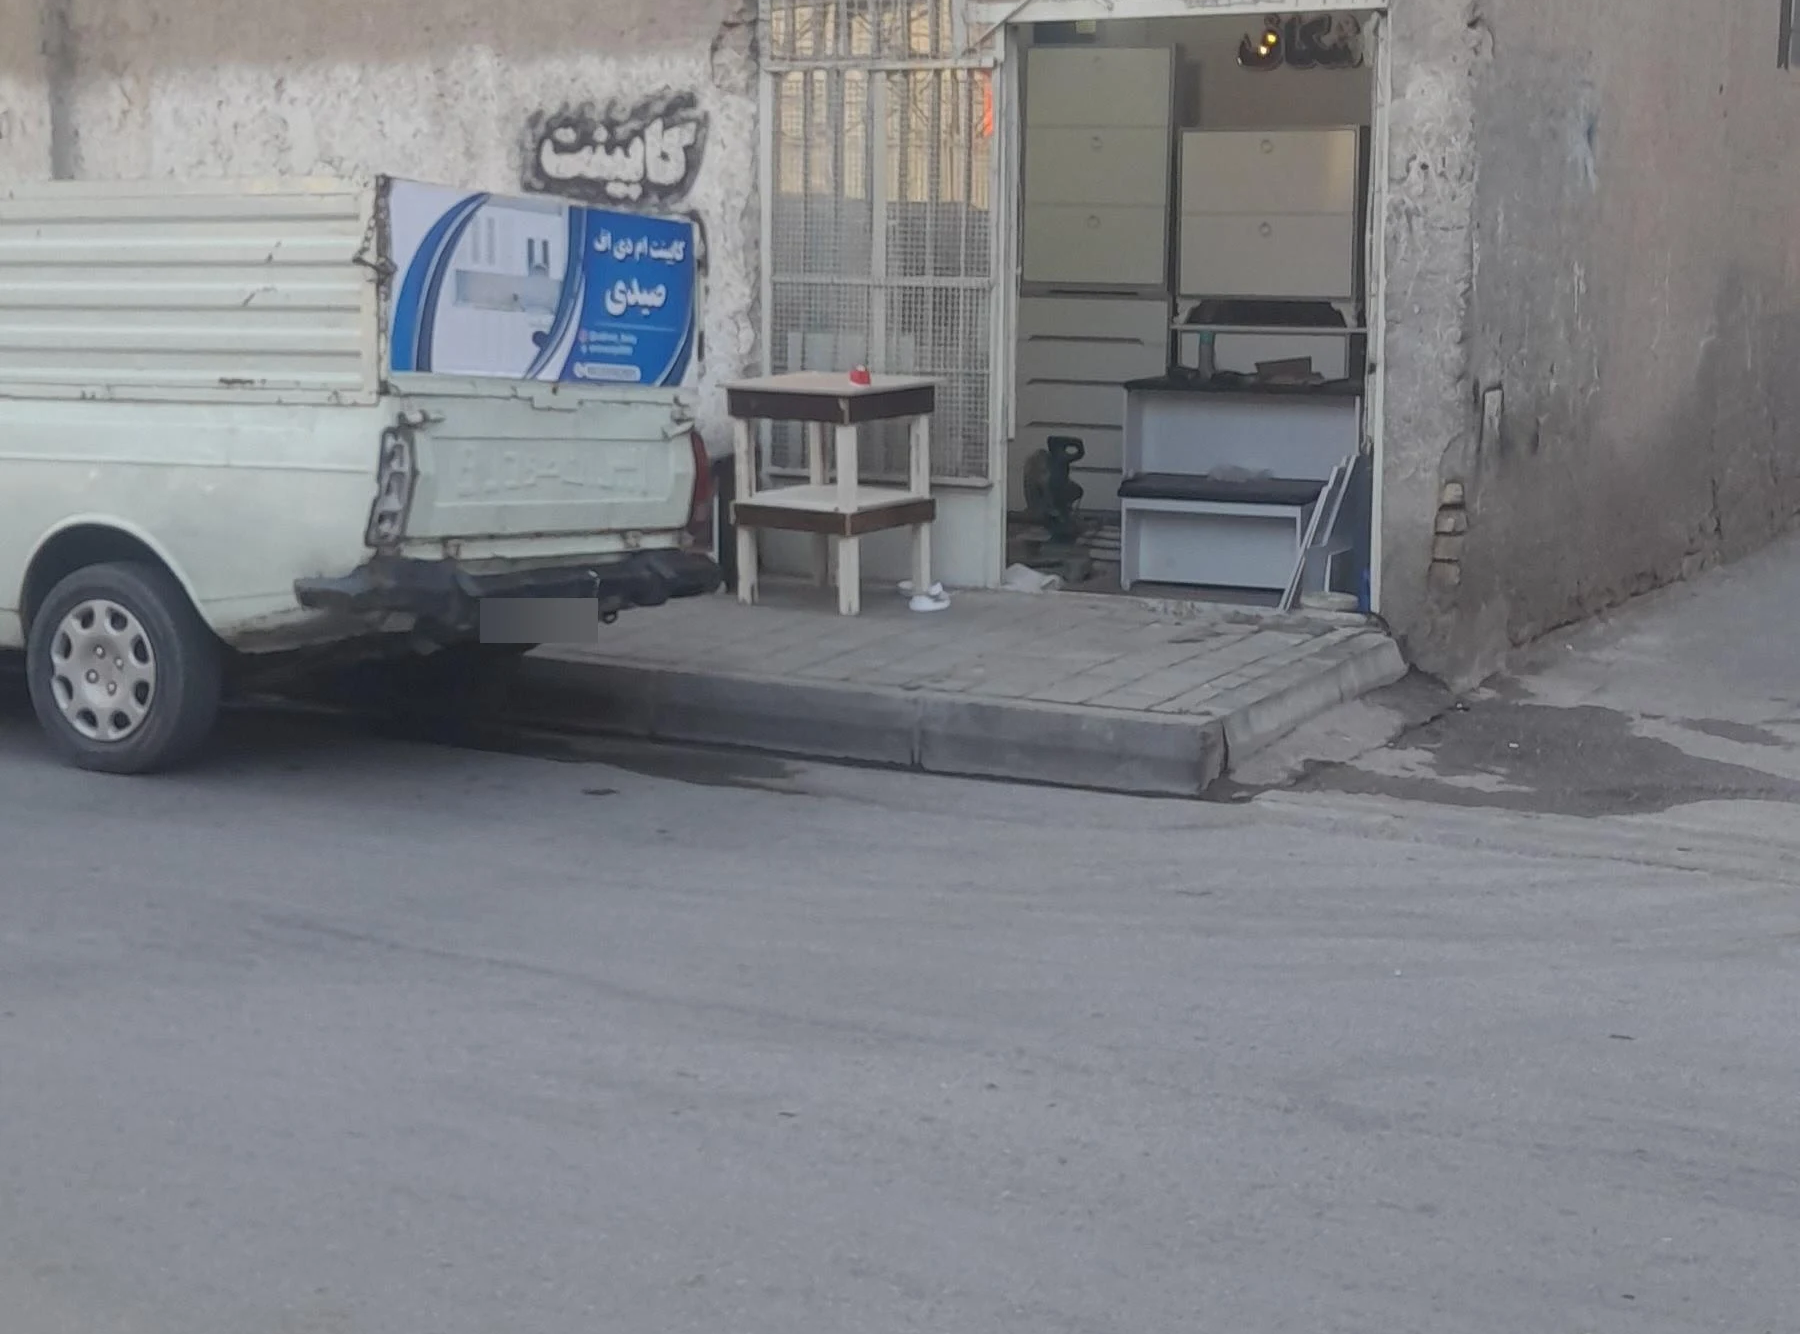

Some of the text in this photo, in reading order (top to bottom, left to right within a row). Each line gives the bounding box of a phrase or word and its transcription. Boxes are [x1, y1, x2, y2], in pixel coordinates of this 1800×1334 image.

[540, 117, 697, 201] کابینت
[593, 227, 686, 265] کابینت ام دی اف
[604, 277, 667, 316] صیدی
